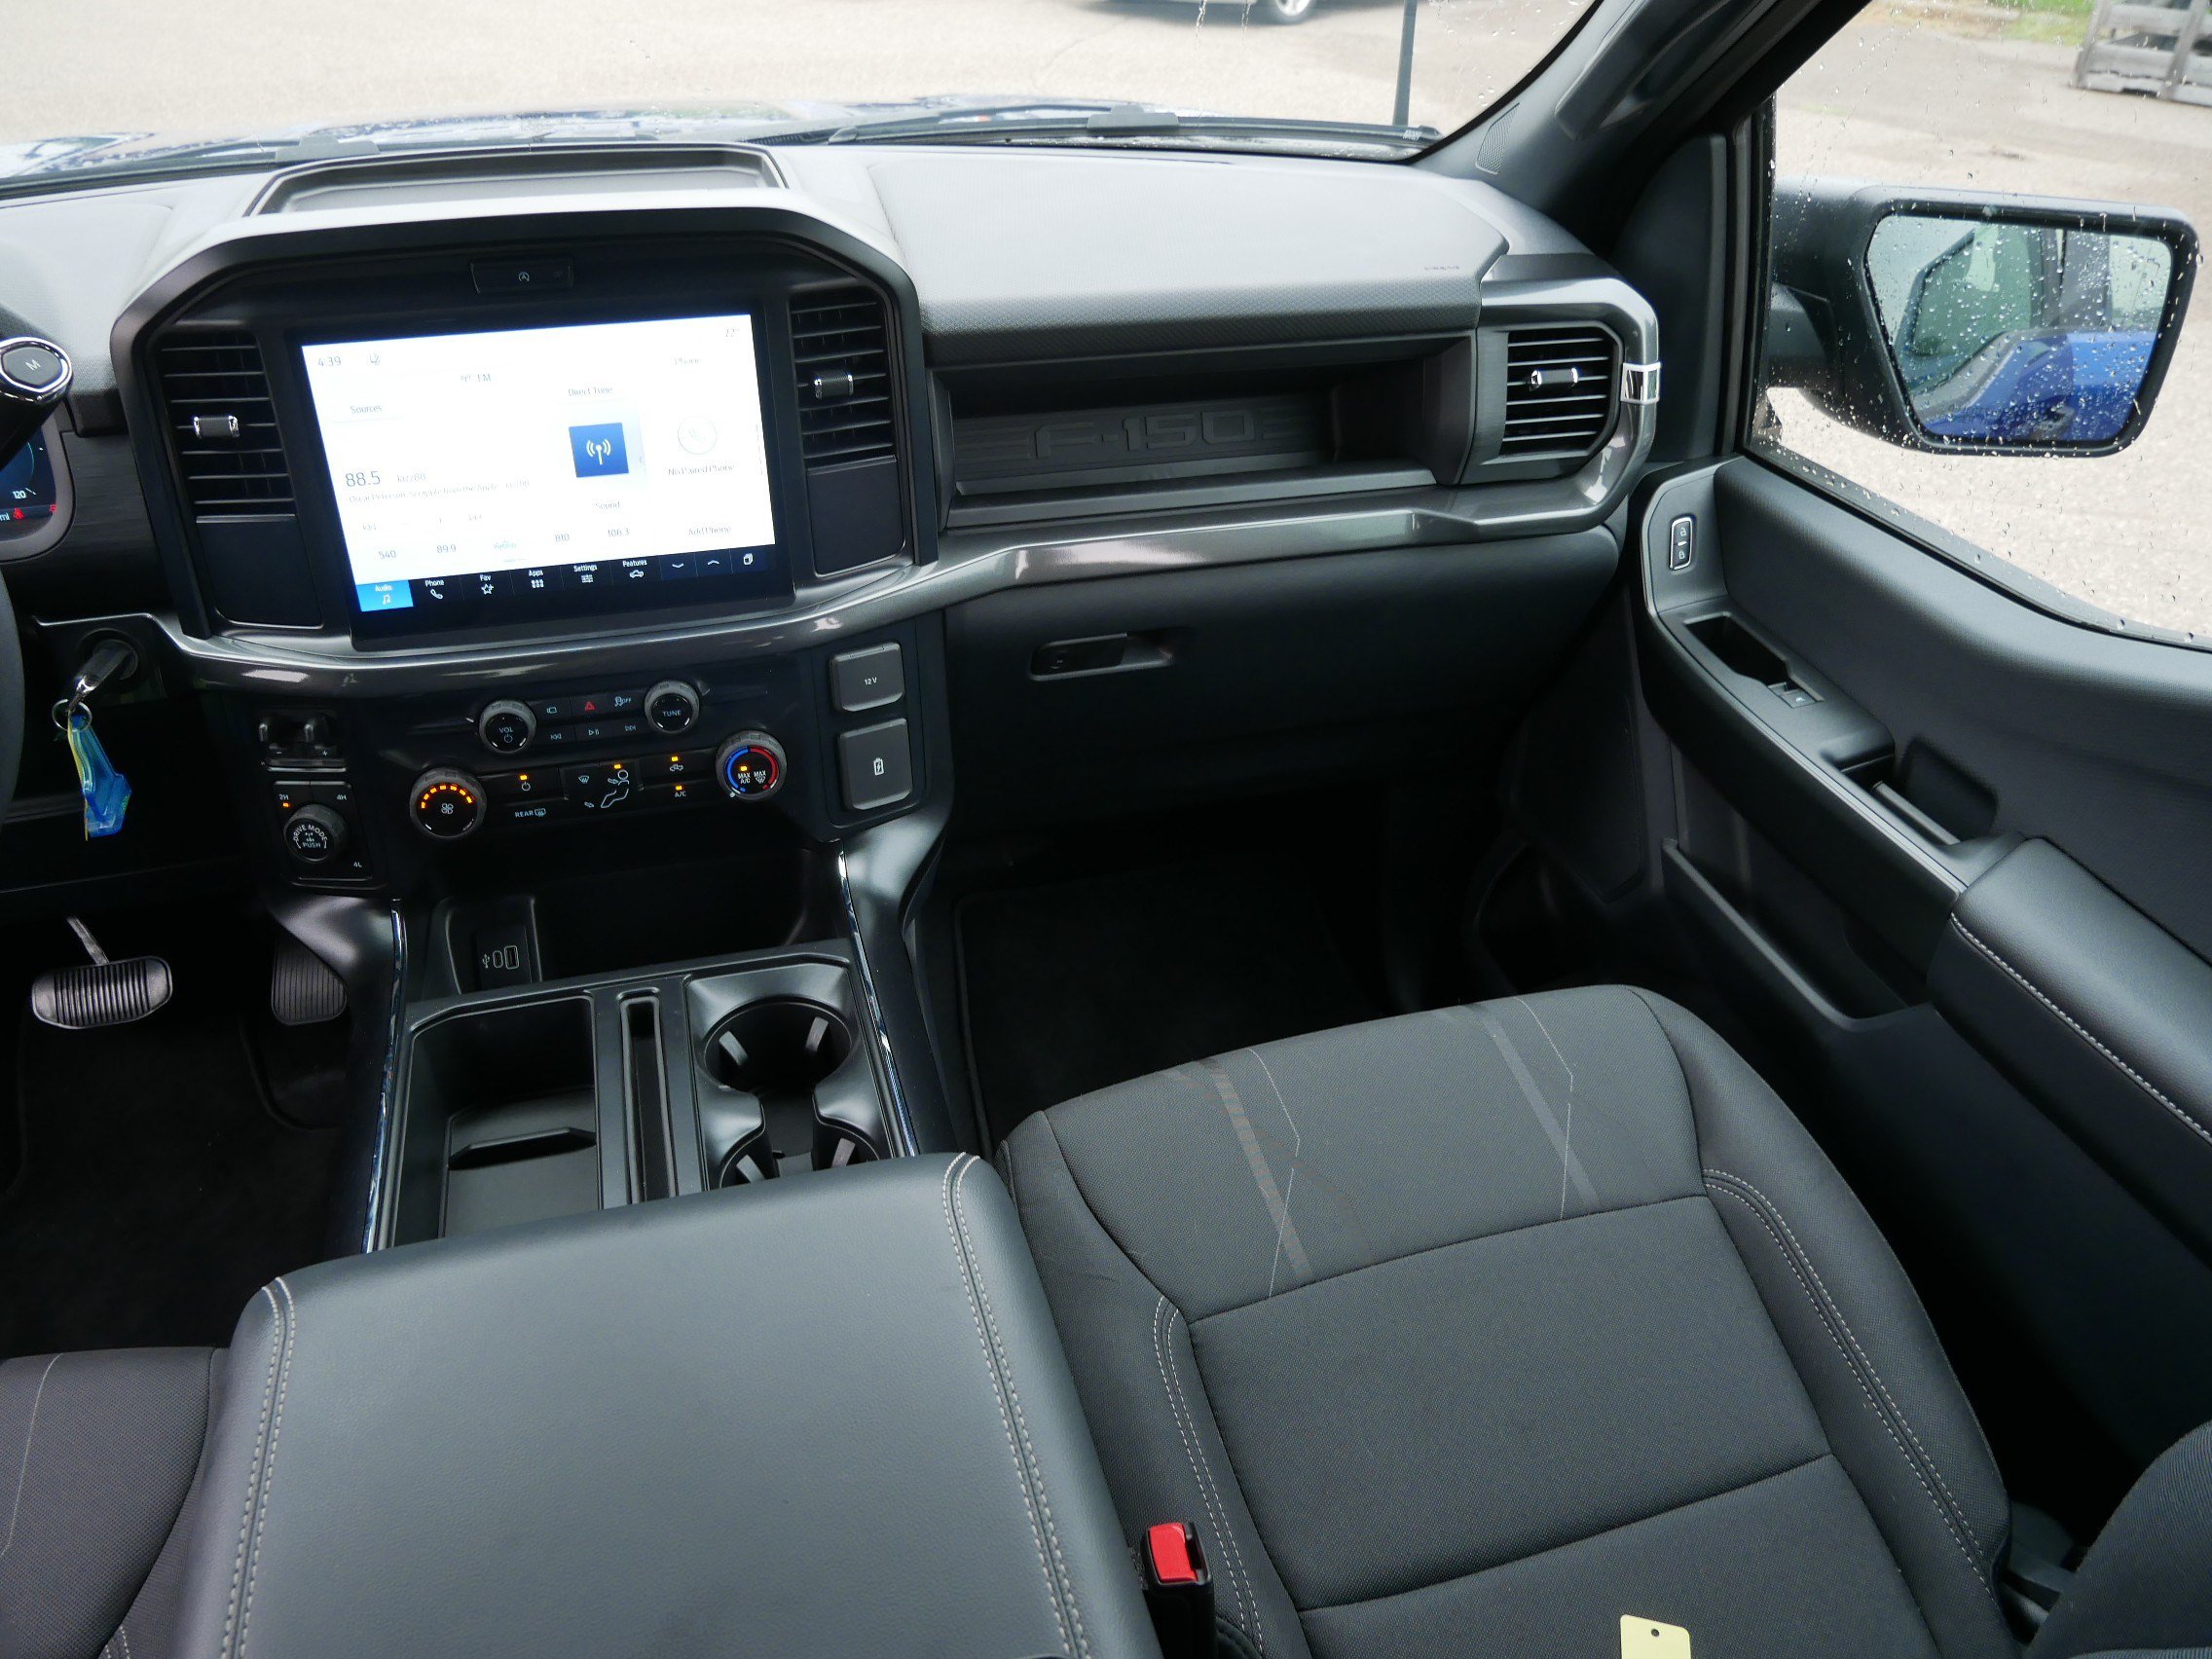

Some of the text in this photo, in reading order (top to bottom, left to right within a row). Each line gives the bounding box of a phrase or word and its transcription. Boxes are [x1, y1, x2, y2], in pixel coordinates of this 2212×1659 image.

[25, 359, 41, 371] M
[350, 404, 382, 414] Sources
[1034, 410, 1255, 459] F-150
[345, 470, 381, 487] 88.5
[13, 490, 27, 499] 120
[573, 564, 598, 572] Settings
[622, 559, 647, 568] Features
[479, 573, 492, 582] Fav
[528, 569, 544, 577] Apps
[424, 578, 446, 587] Phone
[754, 769, 766, 778] MAX
[293, 824, 328, 842] DRIVE MODE
